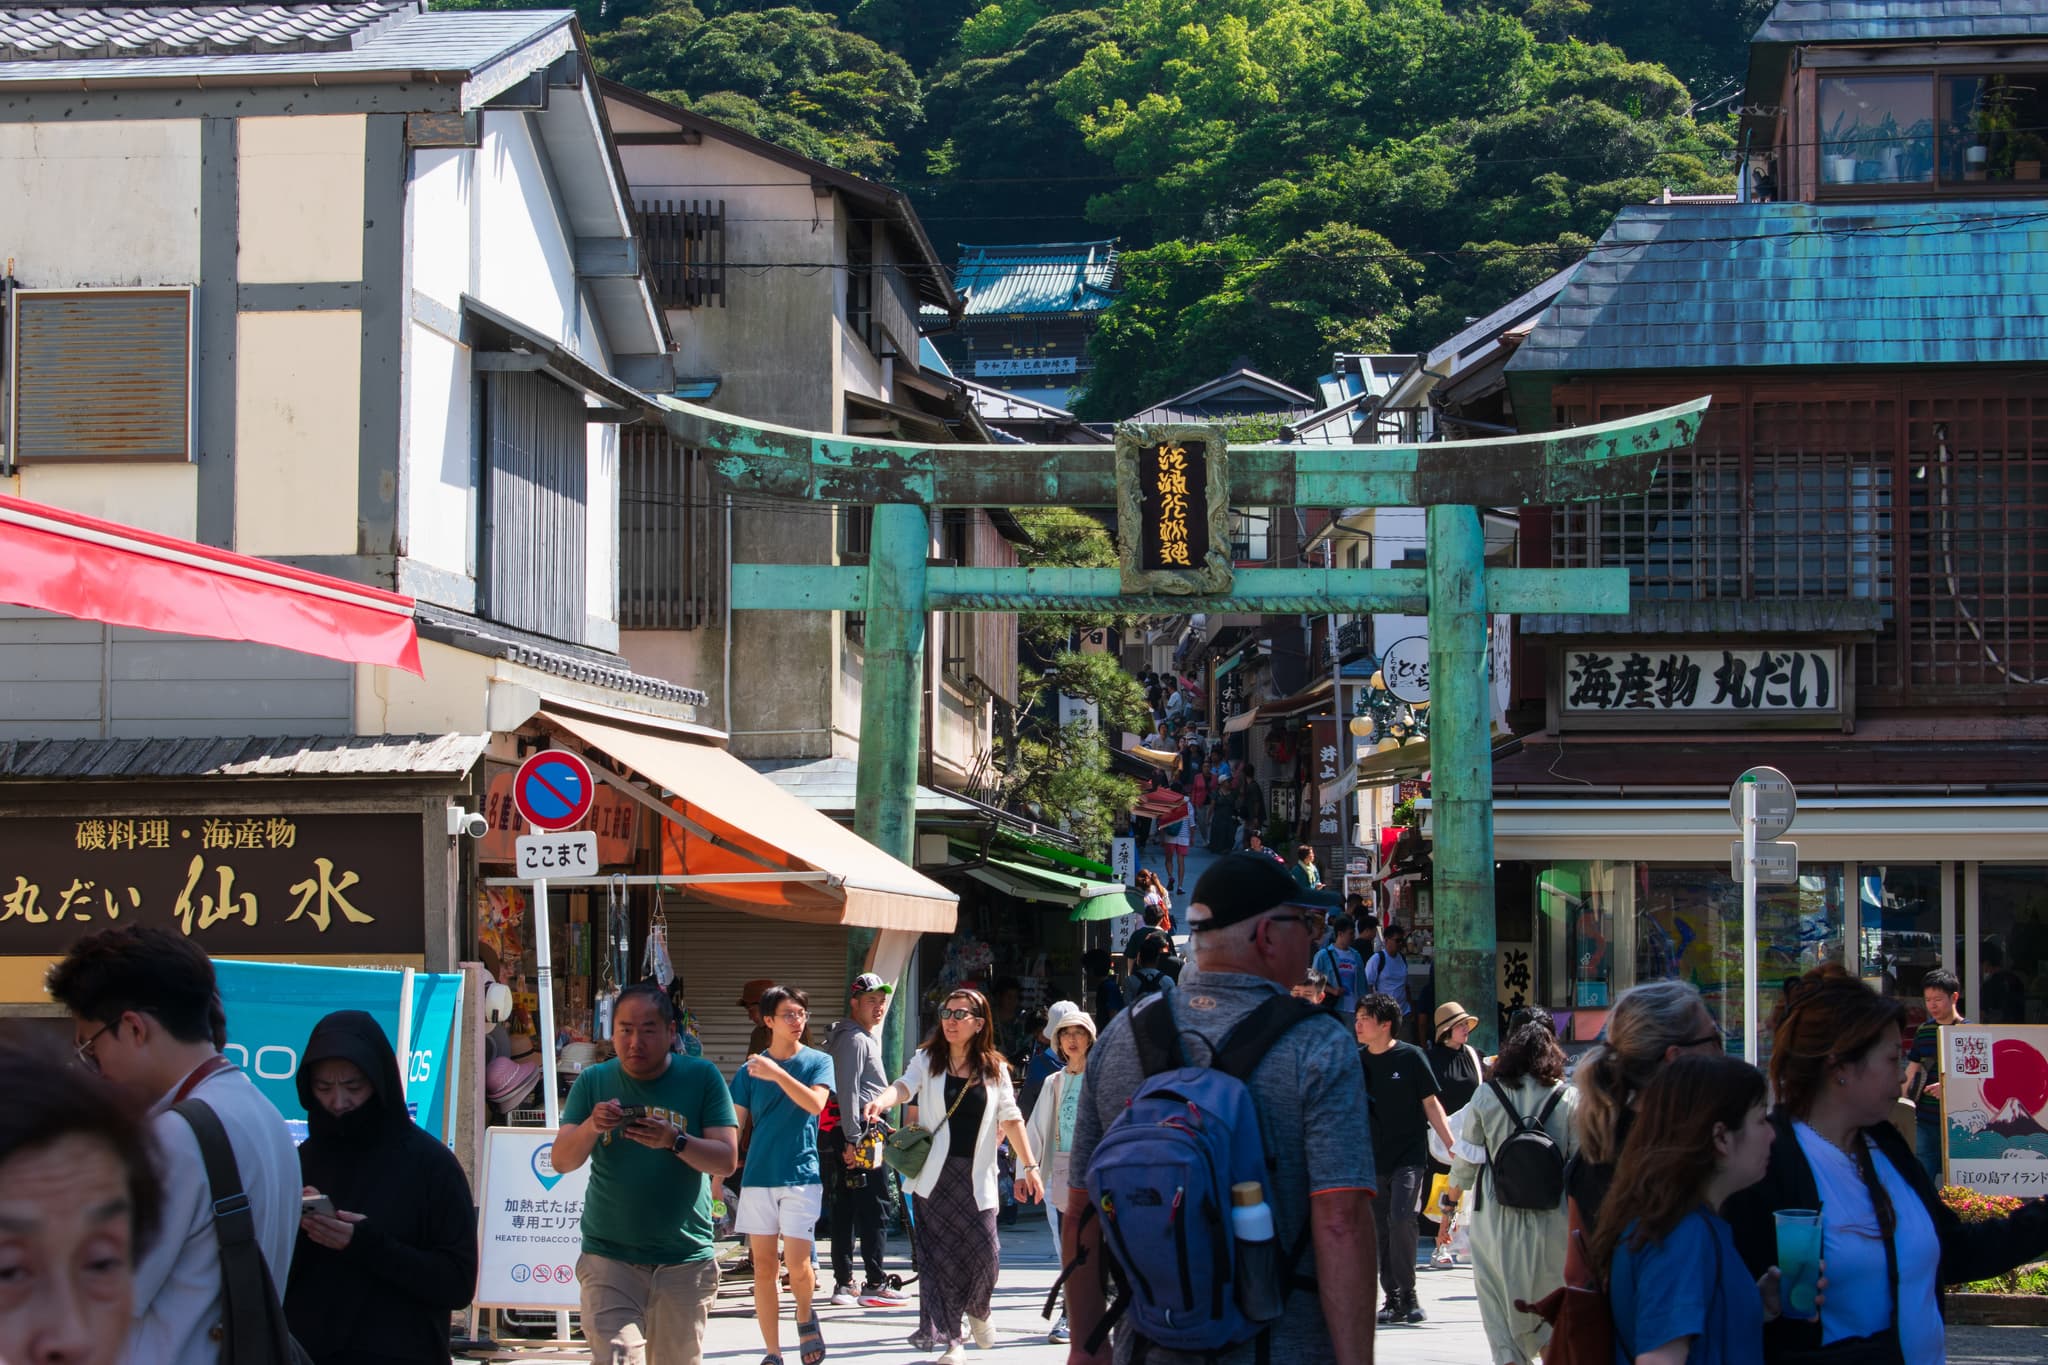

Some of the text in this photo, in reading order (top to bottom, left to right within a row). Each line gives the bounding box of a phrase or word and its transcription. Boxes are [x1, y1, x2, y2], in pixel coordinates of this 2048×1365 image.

[1568, 652, 1701, 709] 海産物
[1711, 650, 1830, 709] 丸だい
[1319, 745, 1338, 834] 井上本舗
[75, 818, 296, 850] 磯料理・海産物
[526, 843, 587, 868] ここまで
[0, 854, 376, 936] 丸だい 仙水
[408, 1049, 433, 1083] OS
[511, 1215, 580, 1229] 専用エリア
[495, 1234, 527, 1243] HEATED
[530, 1235, 570, 1244] TOBACCO
